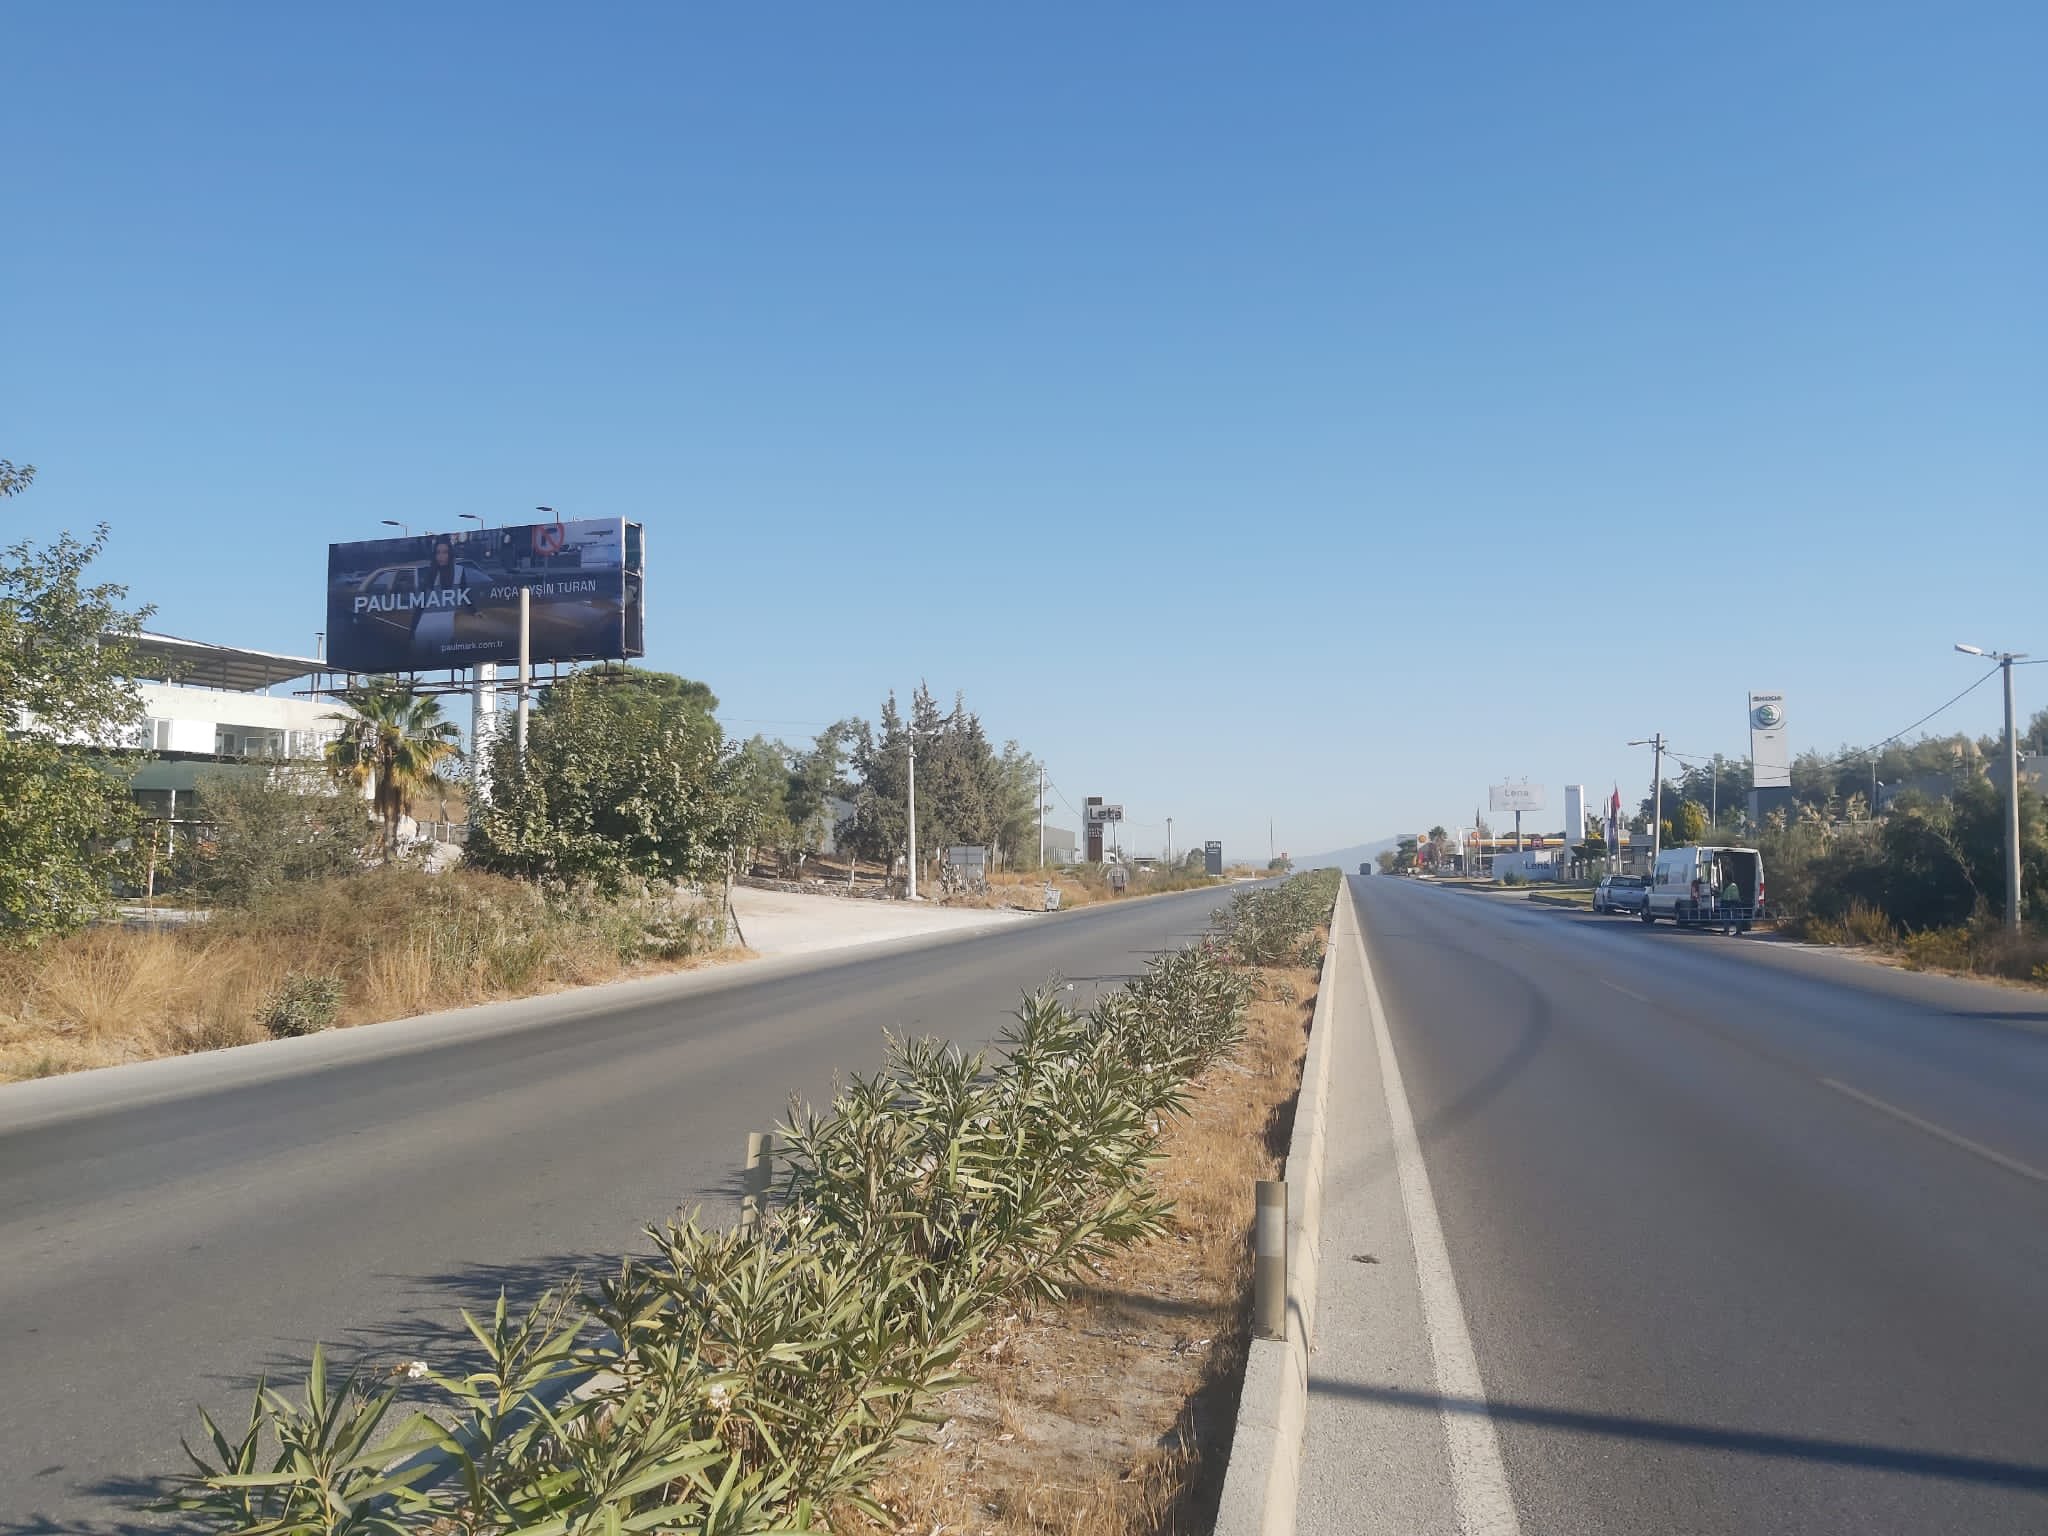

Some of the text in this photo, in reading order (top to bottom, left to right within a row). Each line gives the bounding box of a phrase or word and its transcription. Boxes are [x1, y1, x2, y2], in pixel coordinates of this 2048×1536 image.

[489, 587, 519, 600] AYÇA
[557, 579, 596, 593] TURAN
[353, 588, 472, 614] PAULMARK
[441, 641, 503, 654] paulmark.com.tr
